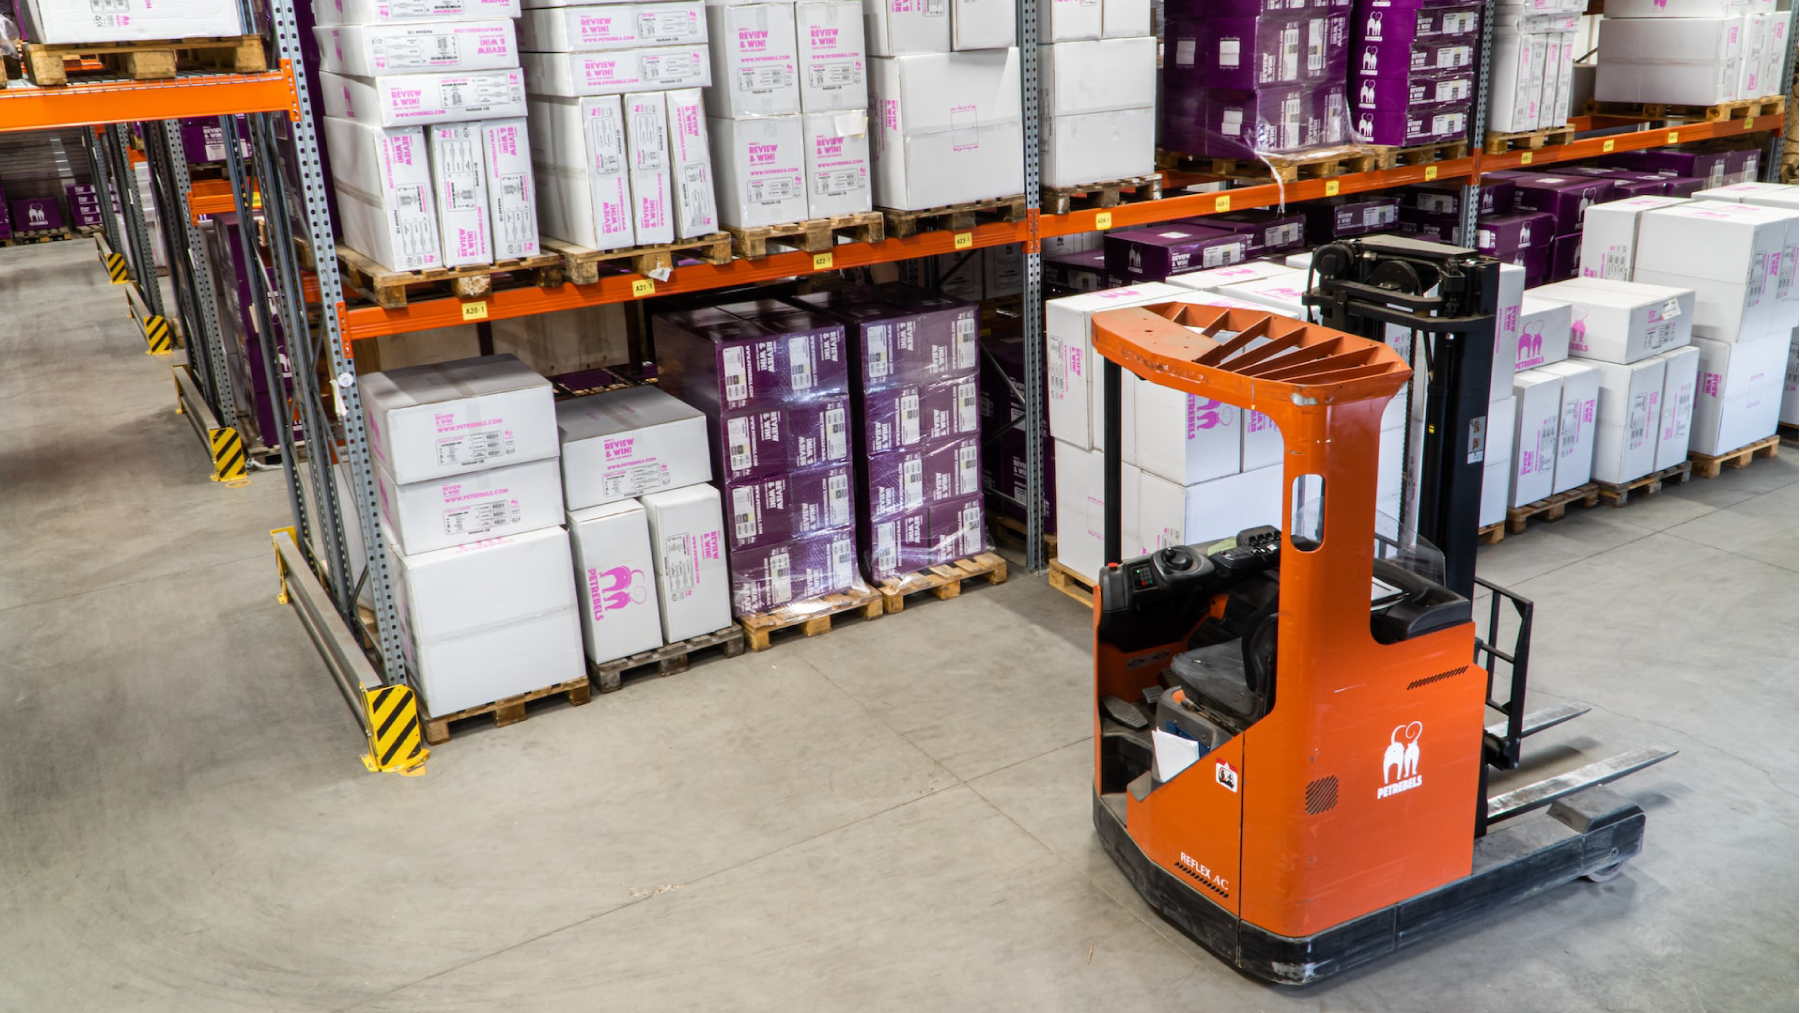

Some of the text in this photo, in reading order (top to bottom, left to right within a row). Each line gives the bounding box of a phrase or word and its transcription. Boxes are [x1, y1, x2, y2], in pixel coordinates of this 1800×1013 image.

[580, 18, 612, 27] REVIEW
[581, 25, 610, 34] & WIN!
[739, 31, 769, 40] REVIEW
[810, 28, 839, 37] REVIEW
[748, 40, 766, 48] WIN!
[811, 37, 836, 46] & WIN!
[585, 61, 616, 70] REVIEW
[586, 68, 614, 77] & WIN!
[391, 90, 421, 99] REVIEW
[401, 98, 420, 106] WIN!
[691, 105, 699, 137] REVIEW
[501, 135, 509, 154] WIN!
[508, 126, 517, 157] REVIEW
[749, 144, 777, 154] REVIEW
[816, 137, 844, 147] REVIEW
[393, 135, 405, 164] & WIN!
[402, 135, 413, 166] REVIEW
[817, 146, 841, 155] & WIN!
[757, 153, 775, 162] WIN!
[603, 202, 612, 233] REVIEW
[610, 204, 618, 227] WIN!
[459, 228, 468, 257] REVIEW
[467, 231, 476, 249] WIN!
[816, 257, 831, 265] A22-1
[636, 284, 653, 293] A21-1
[465, 306, 485, 315] A20-1
[830, 331, 838, 362] REVIEW
[766, 341, 775, 373] REVIEW
[1515, 356, 1544, 369] PETREBELS
[1712, 374, 1720, 398] REVIEW
[1187, 392, 1196, 440] ETREBELS
[770, 411, 779, 442] REVIEW
[604, 438, 634, 450] REVIEW
[613, 447, 632, 456] WIN!
[798, 436, 806, 466] REVIEW
[775, 480, 784, 510] REVIEW
[711, 531, 719, 560] REVIEW
[588, 568, 604, 621] PETREBELS
[1377, 775, 1423, 800] PETREBELS
[1180, 851, 1229, 891] REFLEX AC
